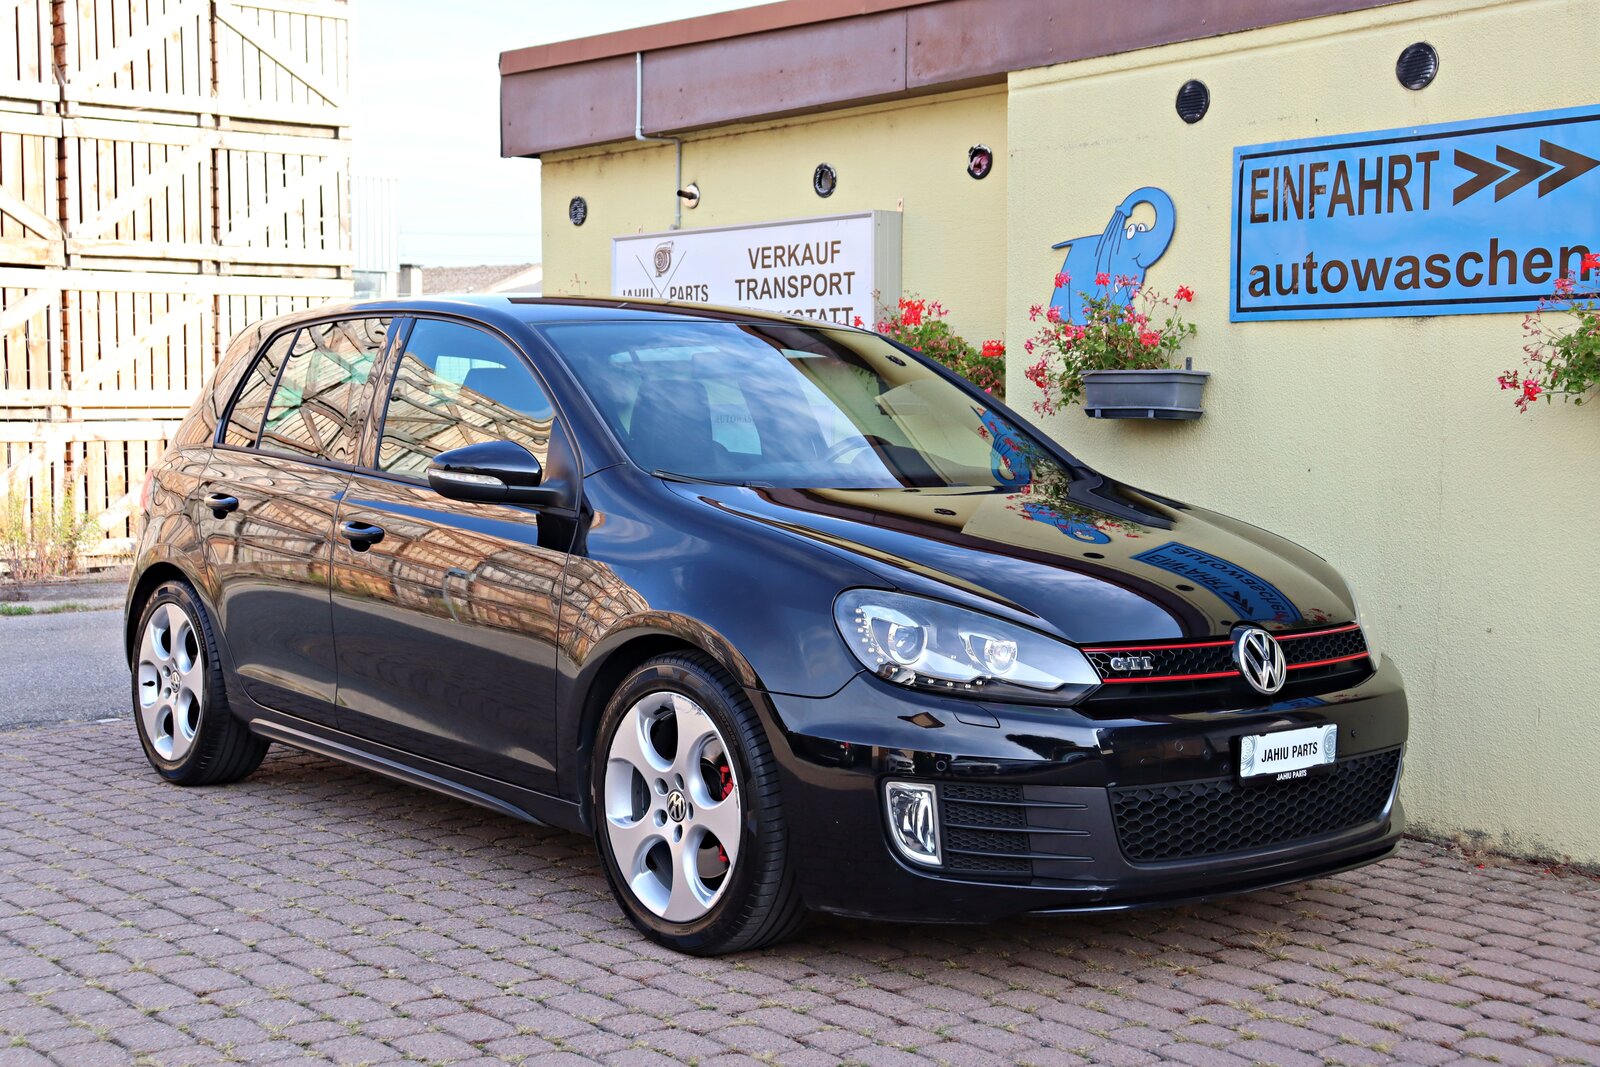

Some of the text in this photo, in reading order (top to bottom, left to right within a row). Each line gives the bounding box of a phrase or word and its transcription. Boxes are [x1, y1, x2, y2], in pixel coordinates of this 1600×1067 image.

[1250, 150, 1440, 224] EINFAHRT
[748, 240, 842, 270] VERKAUF
[1248, 237, 1592, 298] autowaschen
[669, 284, 709, 302] PARTS
[735, 271, 856, 301] TRANSPORT
[1110, 656, 1154, 671] GTI
[1261, 741, 1318, 763] JAHIU PARTS
[1276, 769, 1307, 781] JAHIU PARTS
